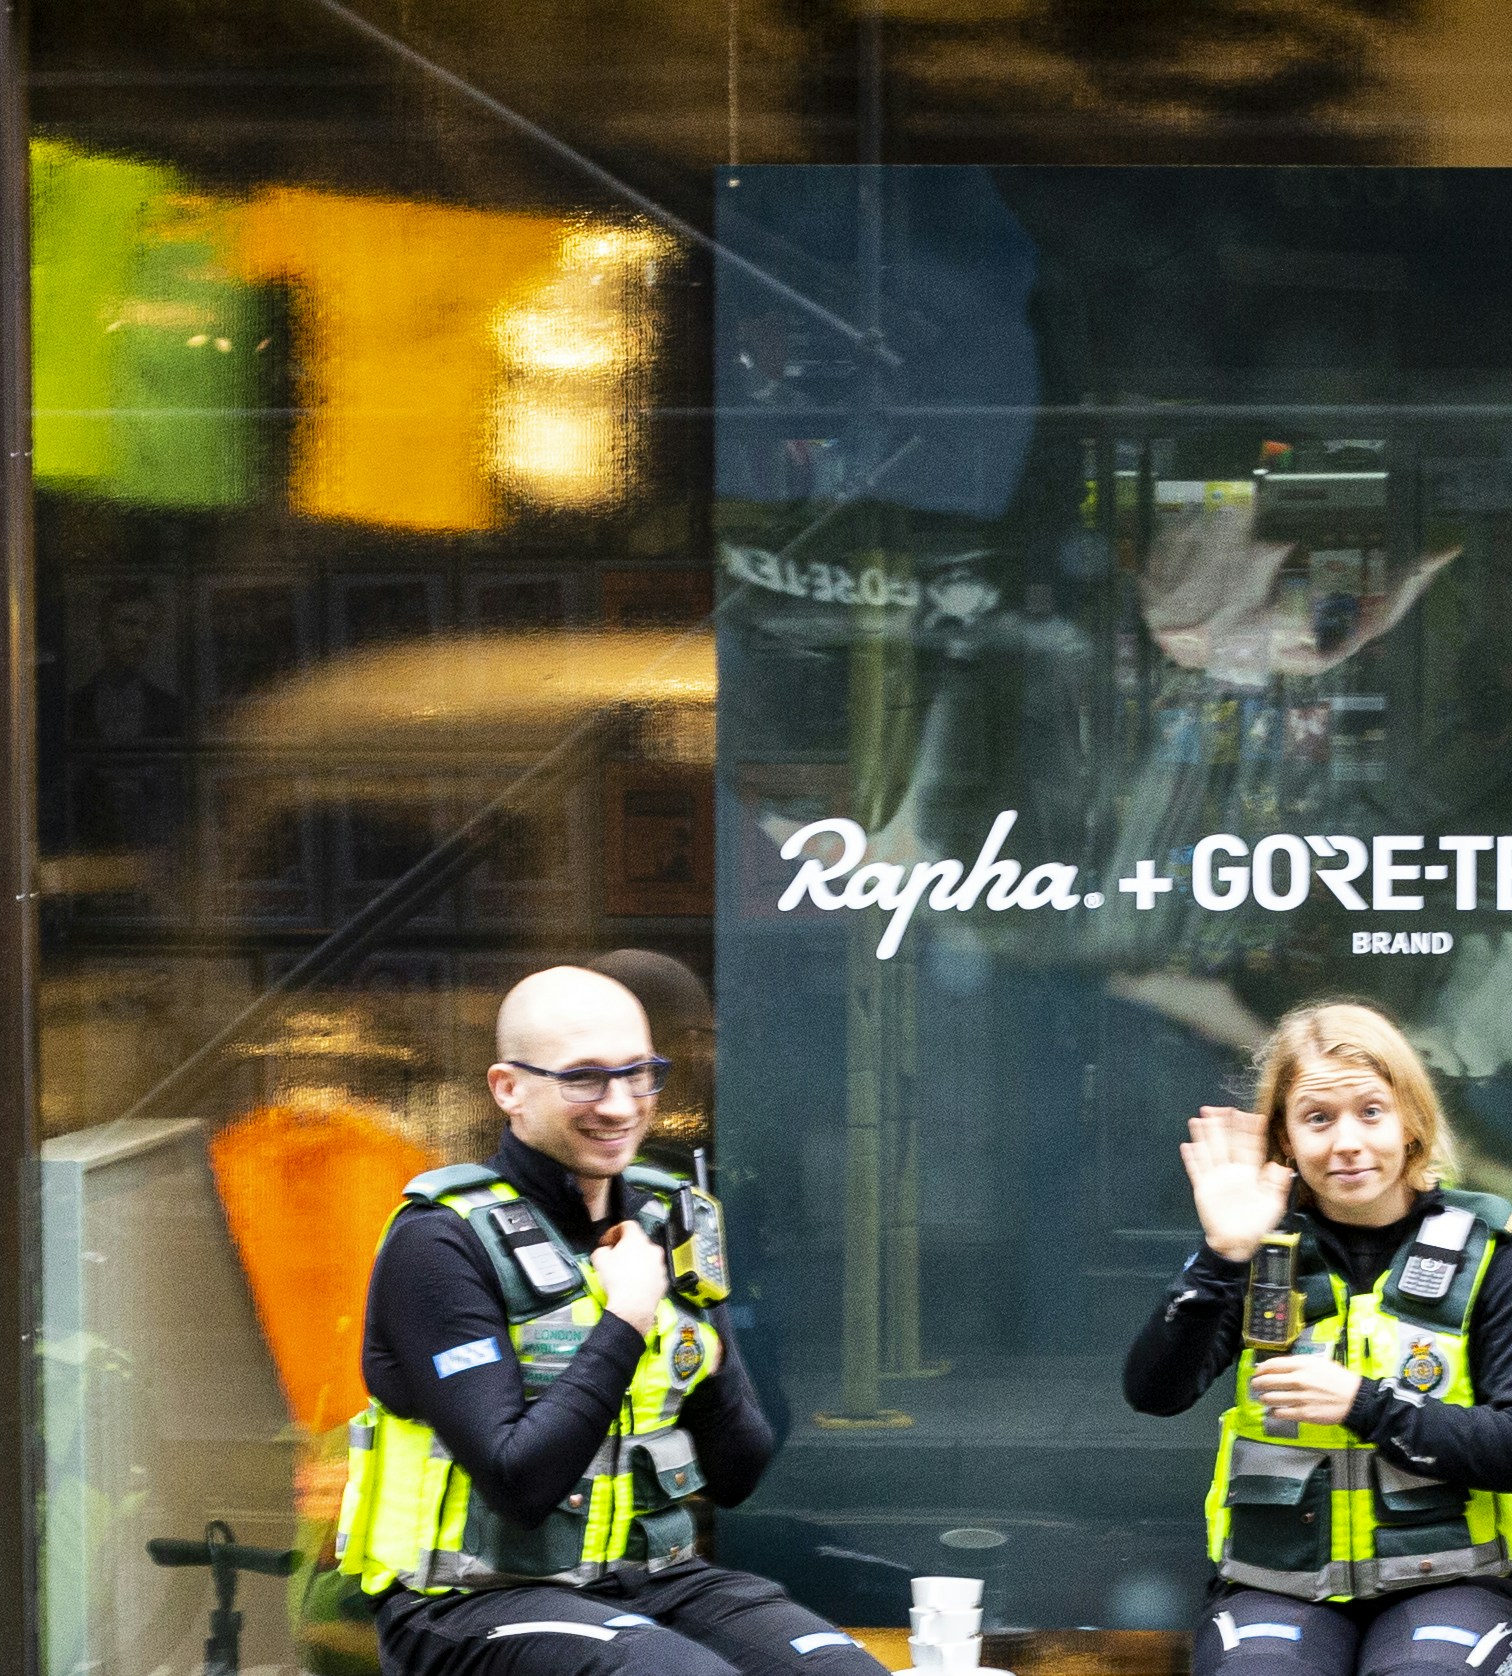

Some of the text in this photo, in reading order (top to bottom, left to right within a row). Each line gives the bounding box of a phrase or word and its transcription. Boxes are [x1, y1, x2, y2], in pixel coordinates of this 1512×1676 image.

[776, 809, 1082, 961] Rapha
[1118, 860, 1173, 910] +
[1352, 932, 1453, 955] BRAND
[534, 1328, 583, 1342] LONDON
